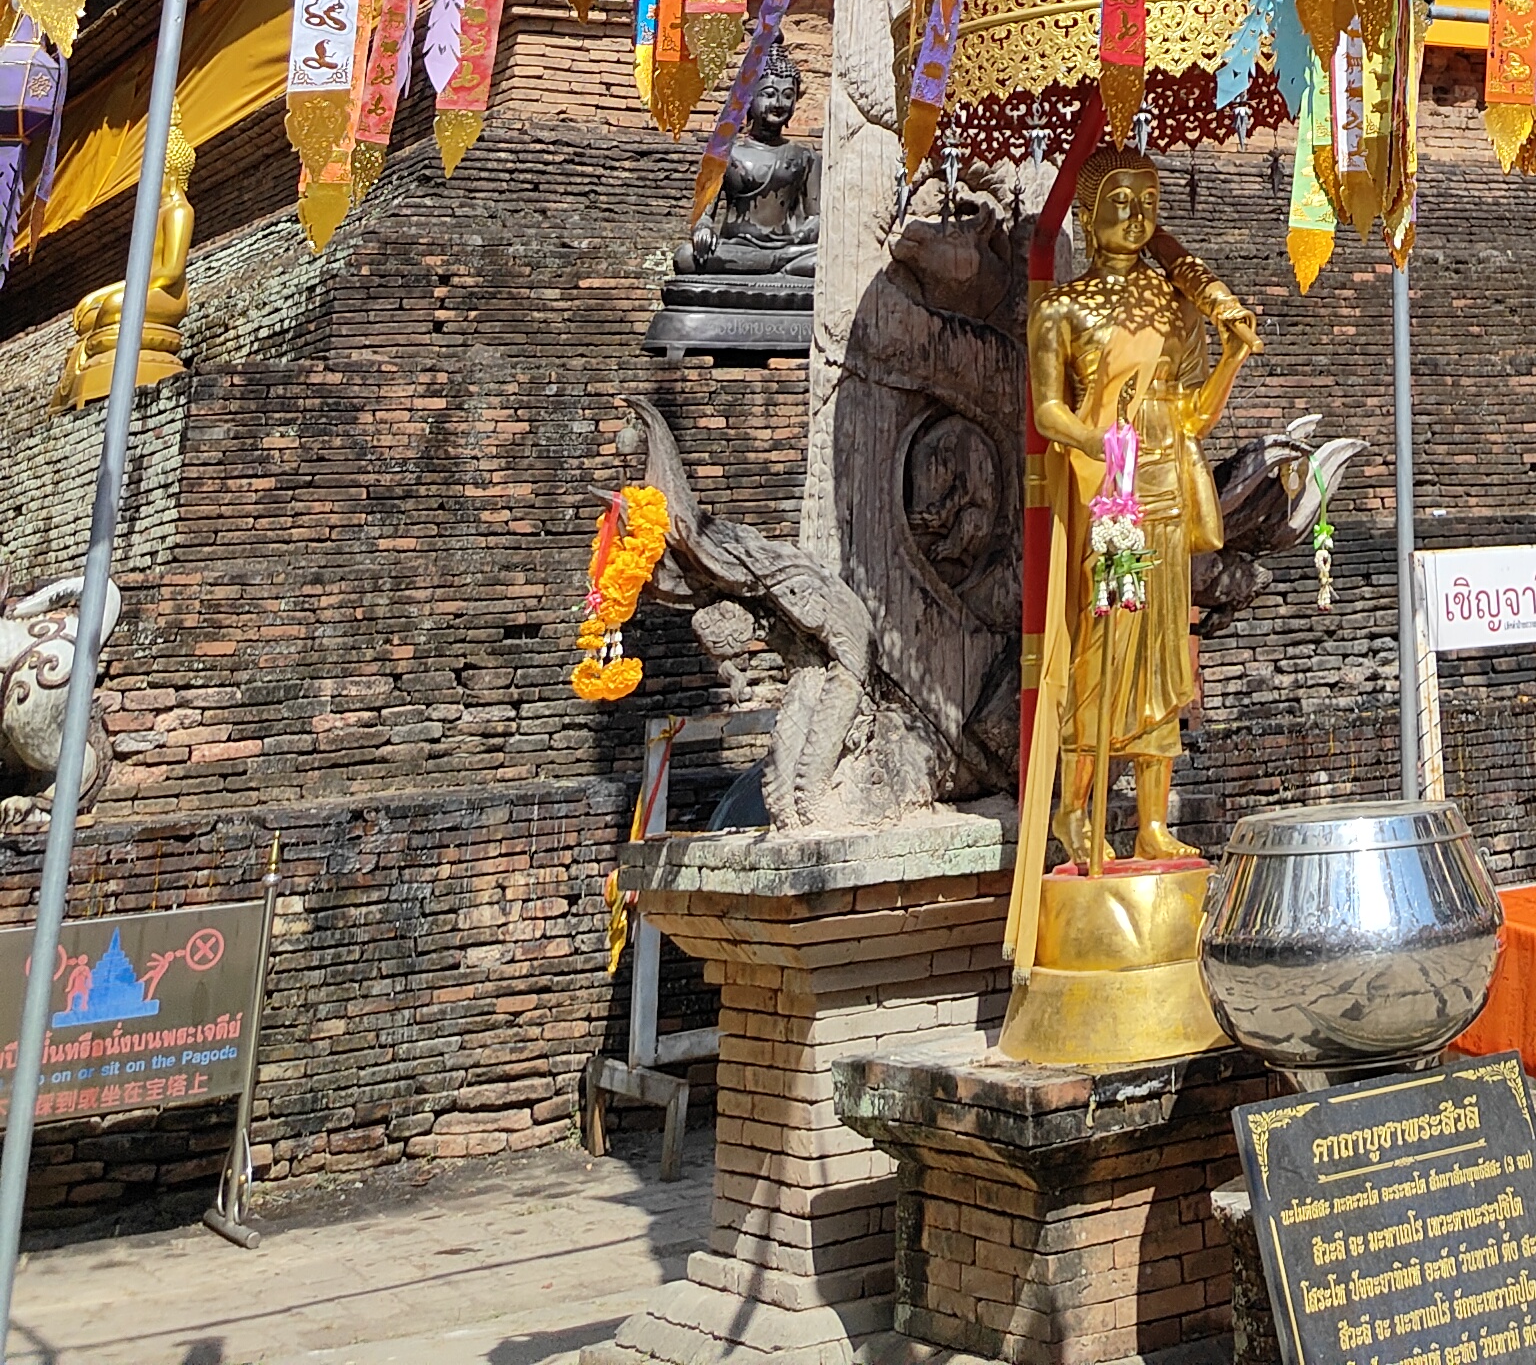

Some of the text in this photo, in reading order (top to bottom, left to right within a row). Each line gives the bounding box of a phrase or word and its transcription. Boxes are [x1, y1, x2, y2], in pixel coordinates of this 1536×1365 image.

[52, 1071, 71, 1084] on
[78, 1067, 95, 1080] or
[101, 1060, 120, 1077] sit
[125, 1060, 146, 1073] on
[151, 1053, 176, 1070] the
[181, 1045, 238, 1067] Pagoda
[1312, 1095, 1481, 1164] คาถาบูชาพระสีวลี
[1312, 1230, 1347, 1266] สีวะลี
[1348, 1235, 1365, 1257] จะ
[1338, 1314, 1373, 1351] สีวะลี
[1374, 1318, 1392, 1342] จะ
